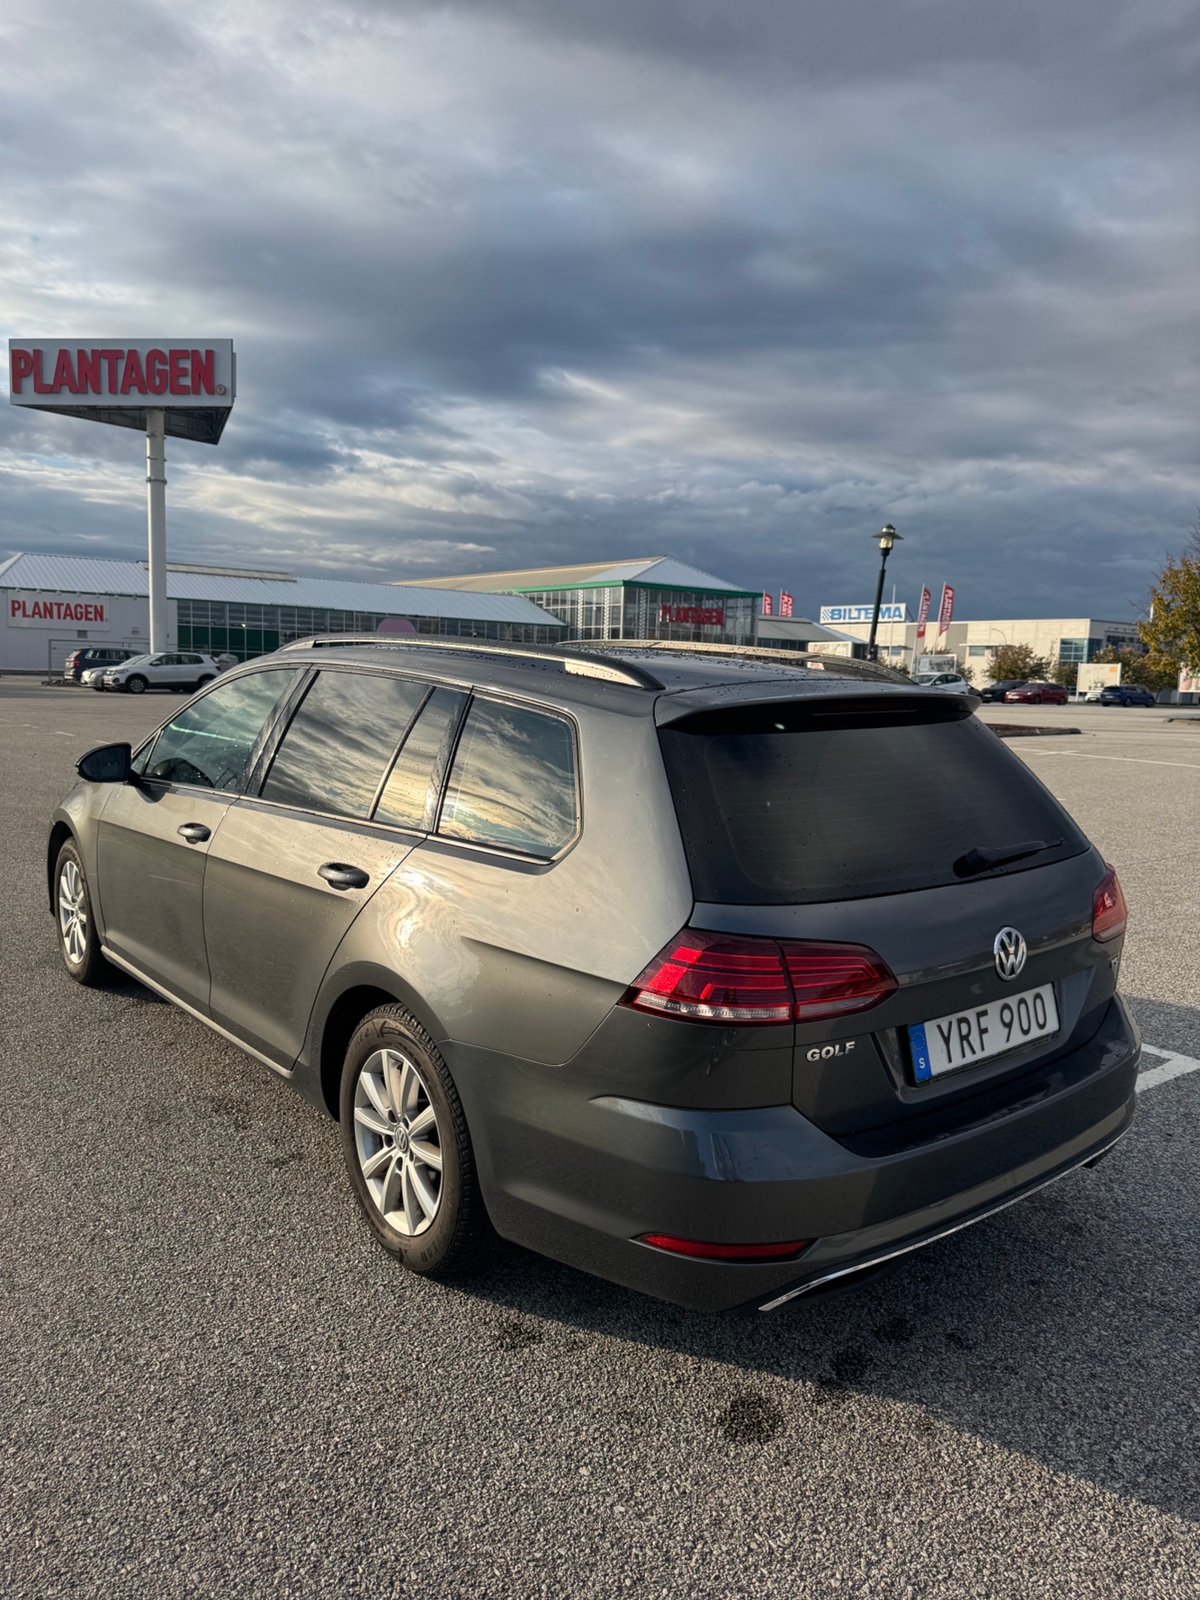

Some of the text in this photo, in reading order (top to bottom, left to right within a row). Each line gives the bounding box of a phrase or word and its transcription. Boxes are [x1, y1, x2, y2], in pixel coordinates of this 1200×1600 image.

[11, 348, 215, 396] PLANTAGEN
[11, 599, 104, 622] PLANTAGEN
[661, 604, 724, 627] PLANTAGEN
[830, 606, 903, 621] BILTEMA
[936, 992, 1047, 1064] YRF 900
[806, 1041, 855, 1062] GOLF
[918, 1057, 926, 1069] S
